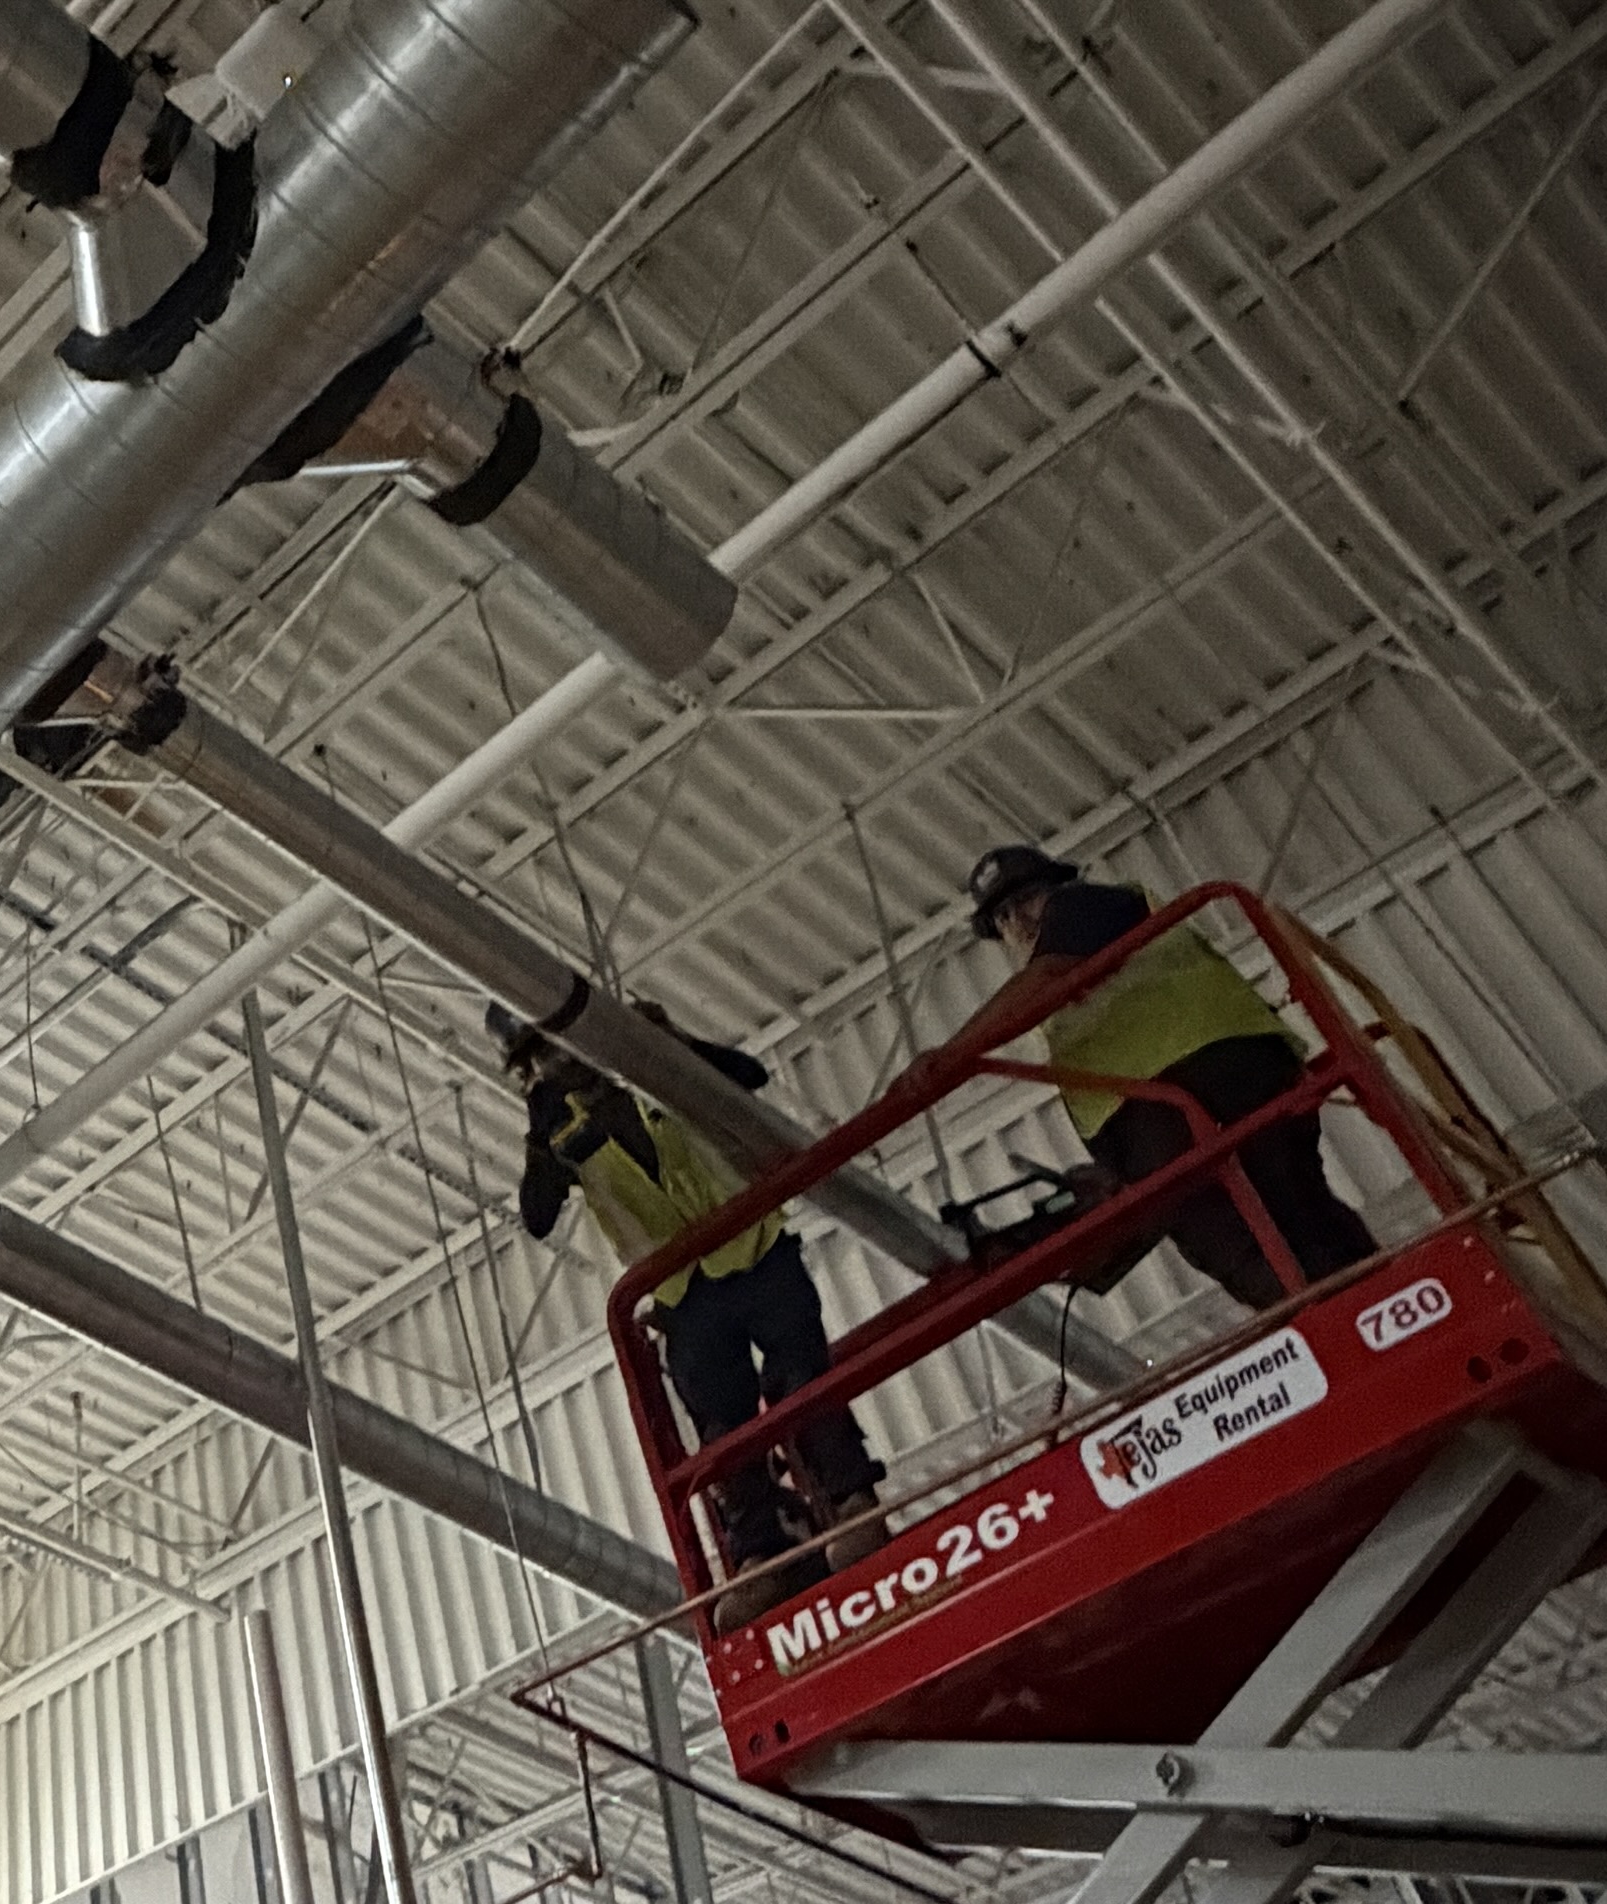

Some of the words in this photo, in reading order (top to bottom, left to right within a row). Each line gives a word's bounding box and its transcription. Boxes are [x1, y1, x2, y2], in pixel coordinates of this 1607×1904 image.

[1360, 1285, 1445, 1343] 780
[1174, 1337, 1299, 1419] Equipment
[1212, 1383, 1292, 1442] Rental
[1108, 1414, 1182, 1489] Tejas
[766, 1488, 1055, 1676] Micro26+
